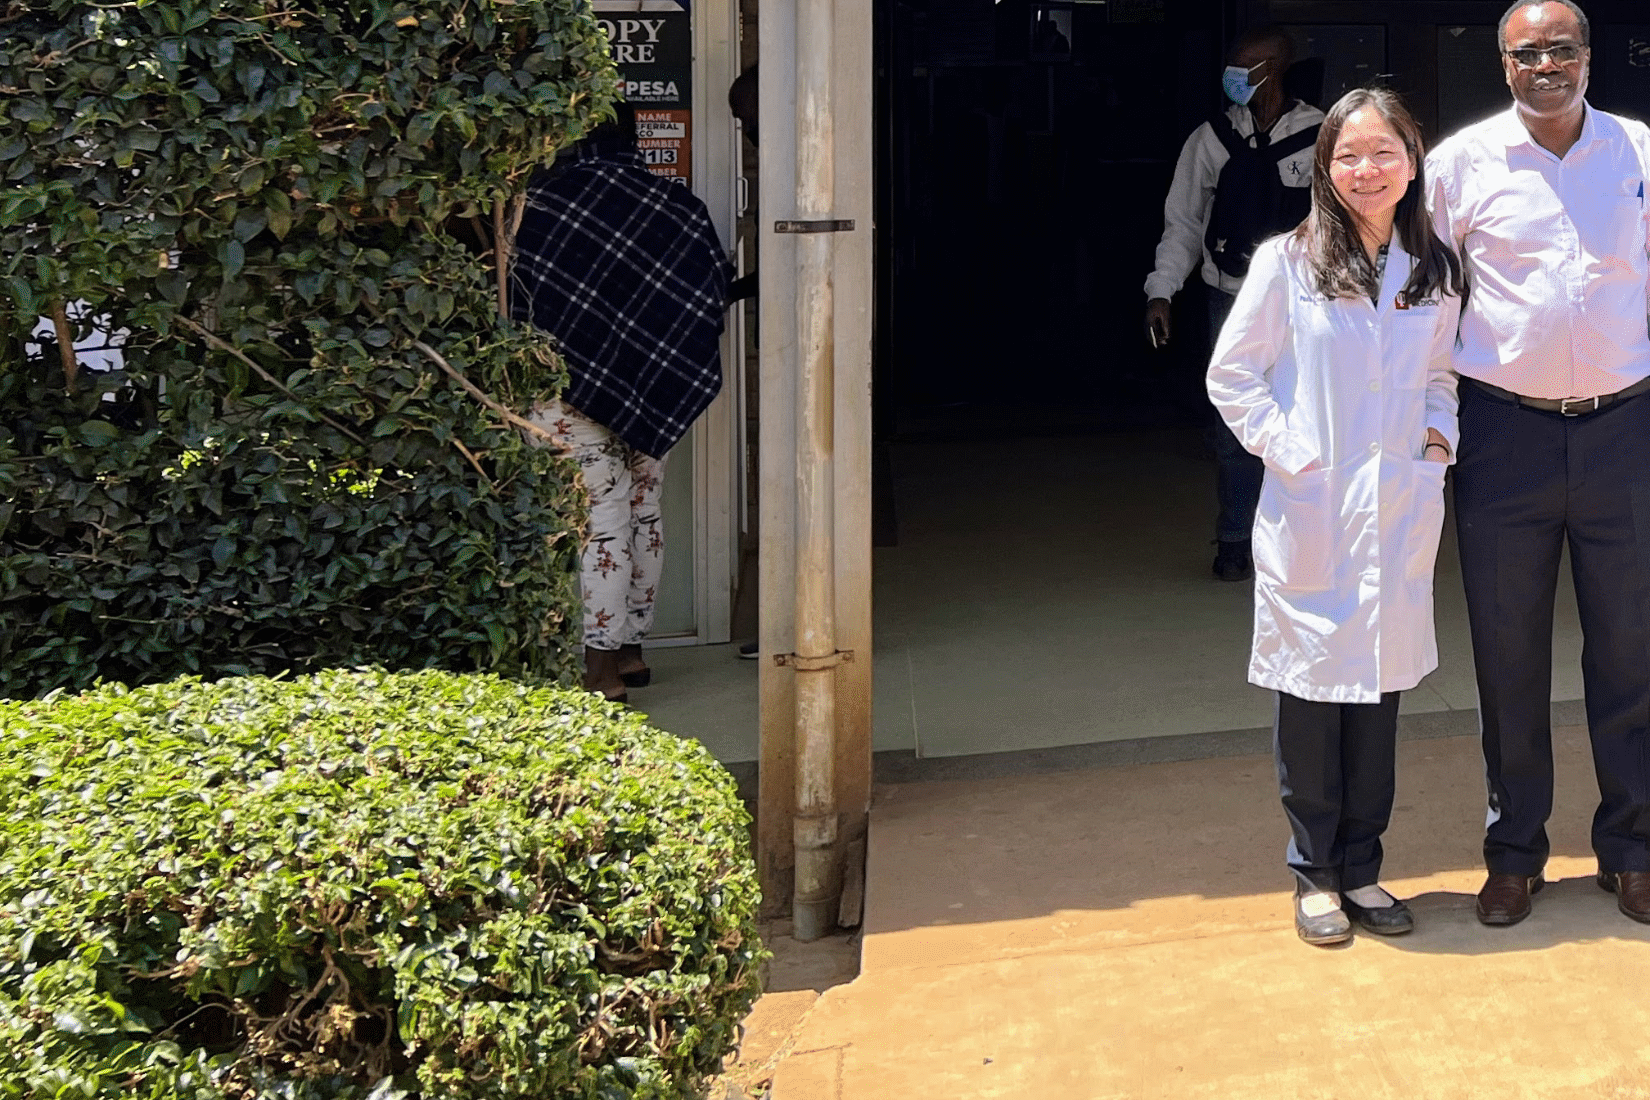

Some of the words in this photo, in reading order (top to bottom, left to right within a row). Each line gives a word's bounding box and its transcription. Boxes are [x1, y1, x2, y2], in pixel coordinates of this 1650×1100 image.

[595, 19, 666, 43] OPY
[637, 113, 672, 121] NAME
[648, 167, 677, 177] MBER
